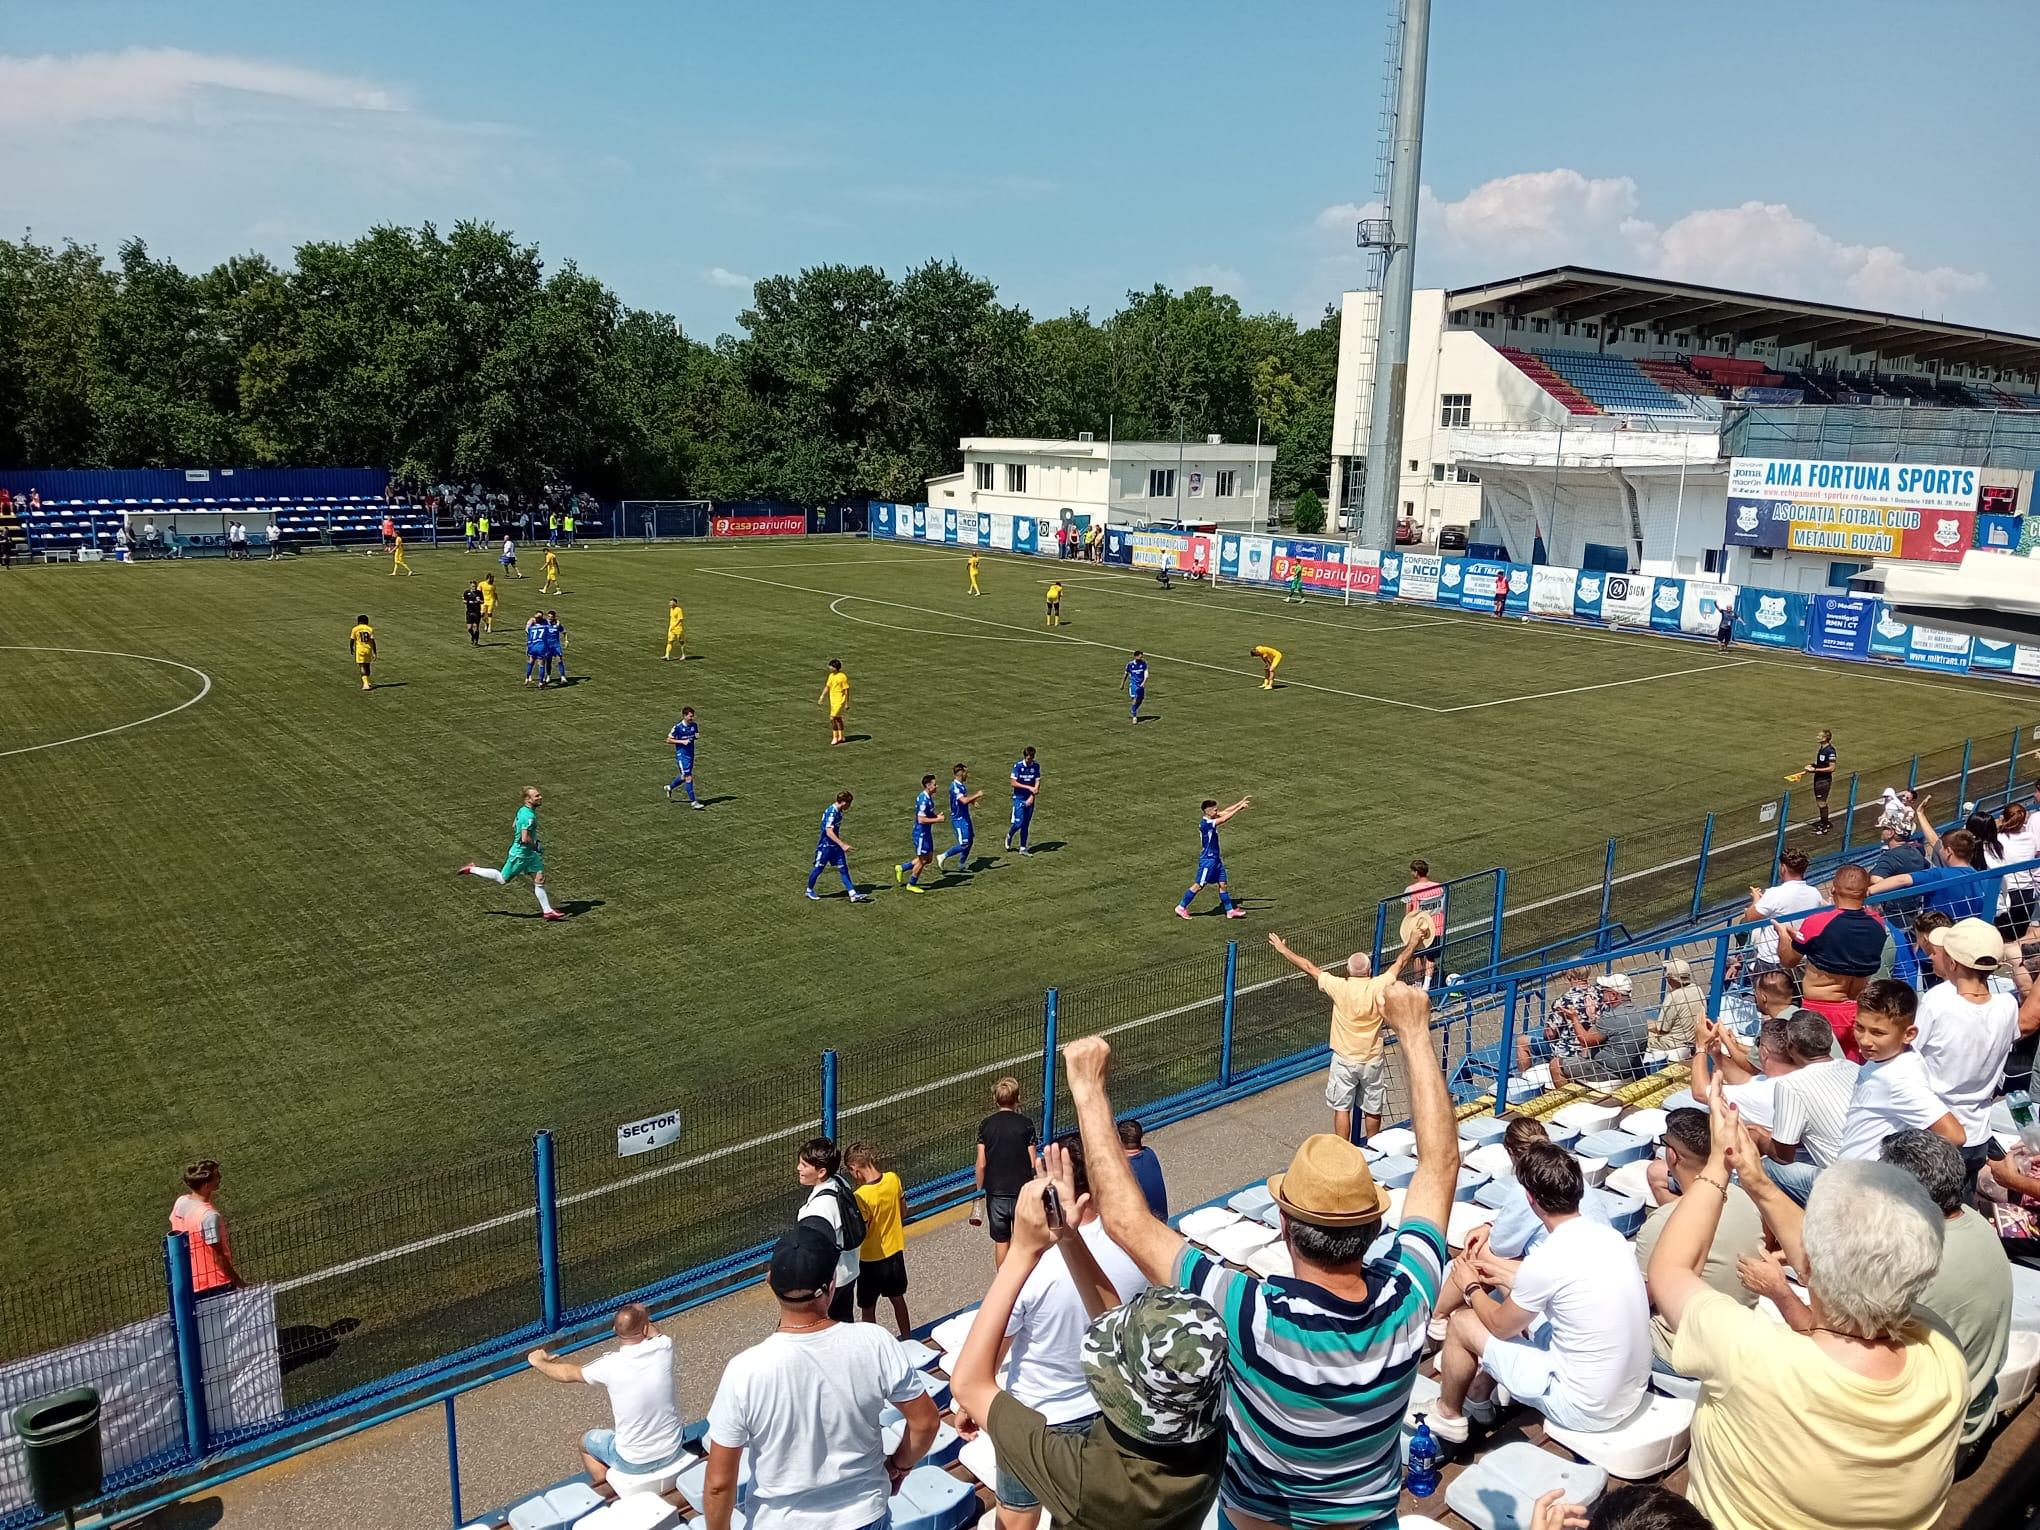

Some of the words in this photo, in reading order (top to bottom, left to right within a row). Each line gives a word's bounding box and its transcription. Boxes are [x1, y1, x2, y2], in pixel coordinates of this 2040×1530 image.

[1765, 462, 1802, 486] AMA
[1808, 464, 1890, 491] FORTUNA
[1897, 468, 1974, 496] SPORTS
[1839, 507, 1882, 526] FOTBAL
[1887, 511, 1920, 529] CLUB
[1794, 530, 1847, 549] METALUL
[1851, 531, 1892, 552] BUZĂU
[1289, 563, 1314, 578] csa
[1612, 583, 1623, 595] 24
[1629, 584, 1646, 597] SIGN
[1825, 619, 1843, 629] RMN
[532, 628, 545, 640] 77
[623, 1115, 676, 1138] SECTOR
[646, 1135, 655, 1145] 4
